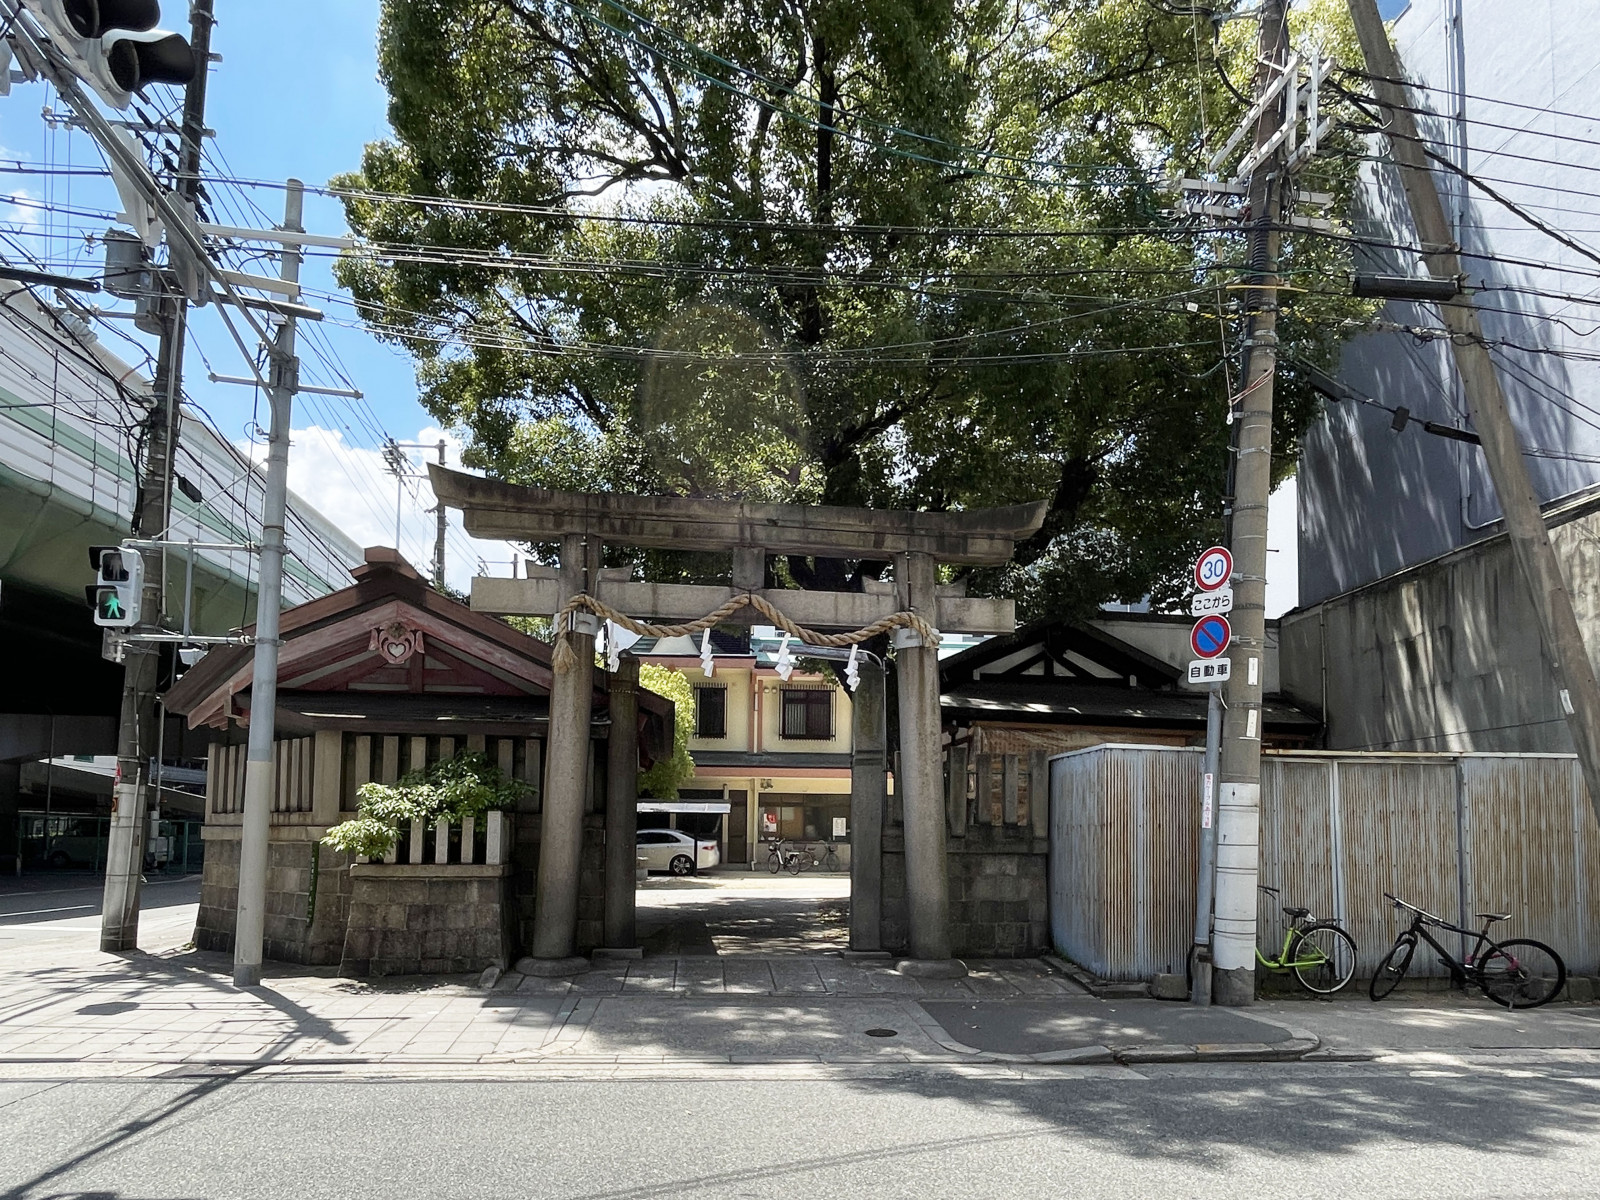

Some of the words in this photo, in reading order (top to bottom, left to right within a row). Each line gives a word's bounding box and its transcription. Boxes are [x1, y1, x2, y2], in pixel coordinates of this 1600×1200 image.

[1203, 559, 1224, 580] 30
[1194, 595, 1230, 611] ここから
[1191, 664, 1228, 678] 自動車
